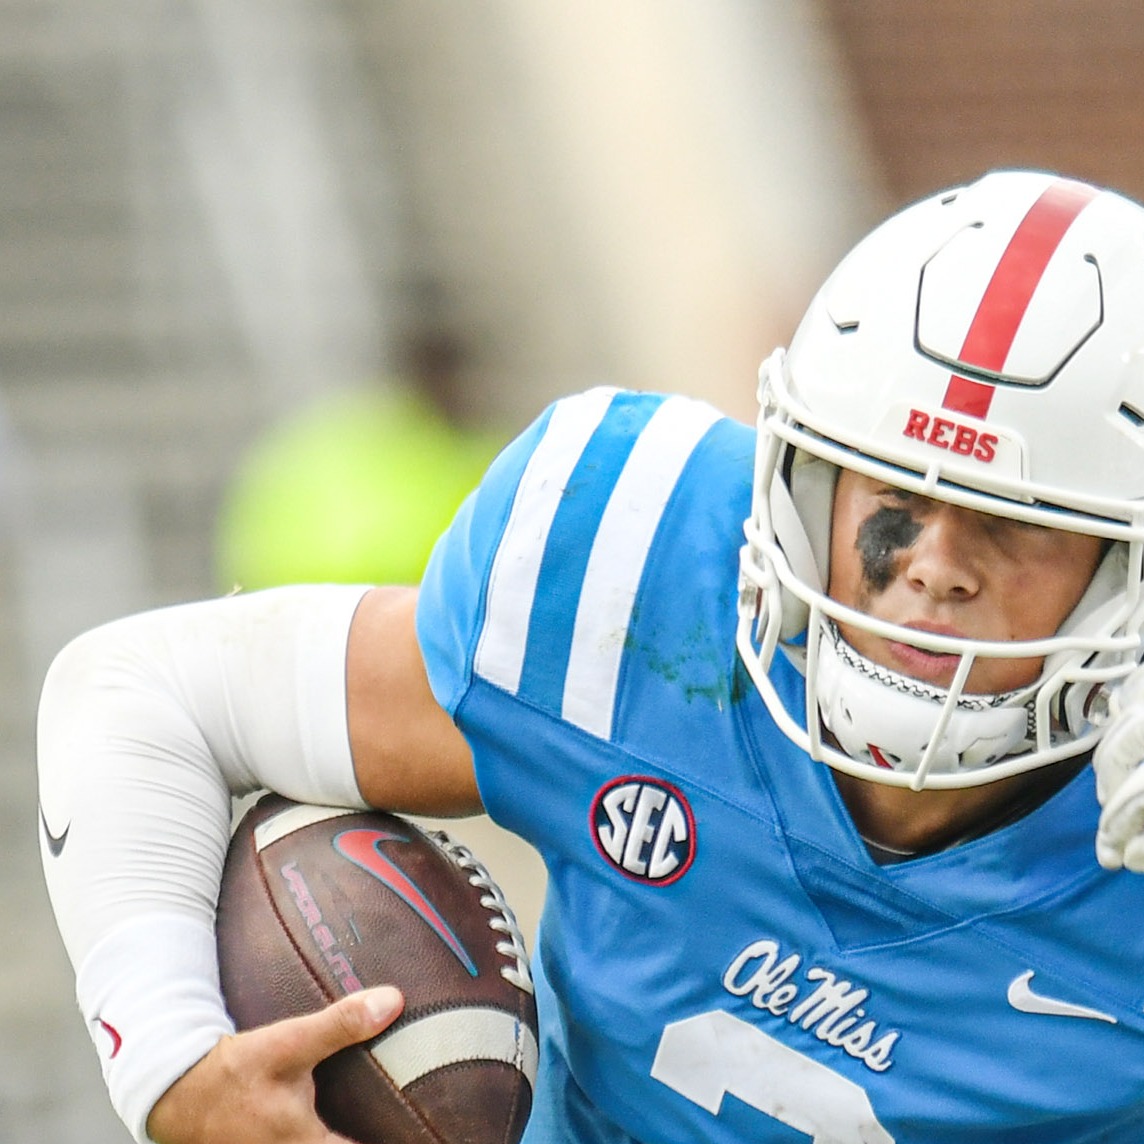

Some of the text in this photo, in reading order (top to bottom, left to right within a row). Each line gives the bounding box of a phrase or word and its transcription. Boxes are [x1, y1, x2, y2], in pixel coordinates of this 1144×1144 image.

[903, 408, 999, 463] REBS
[598, 783, 687, 879] SEC
[723, 940, 899, 1071] Ole Miss
